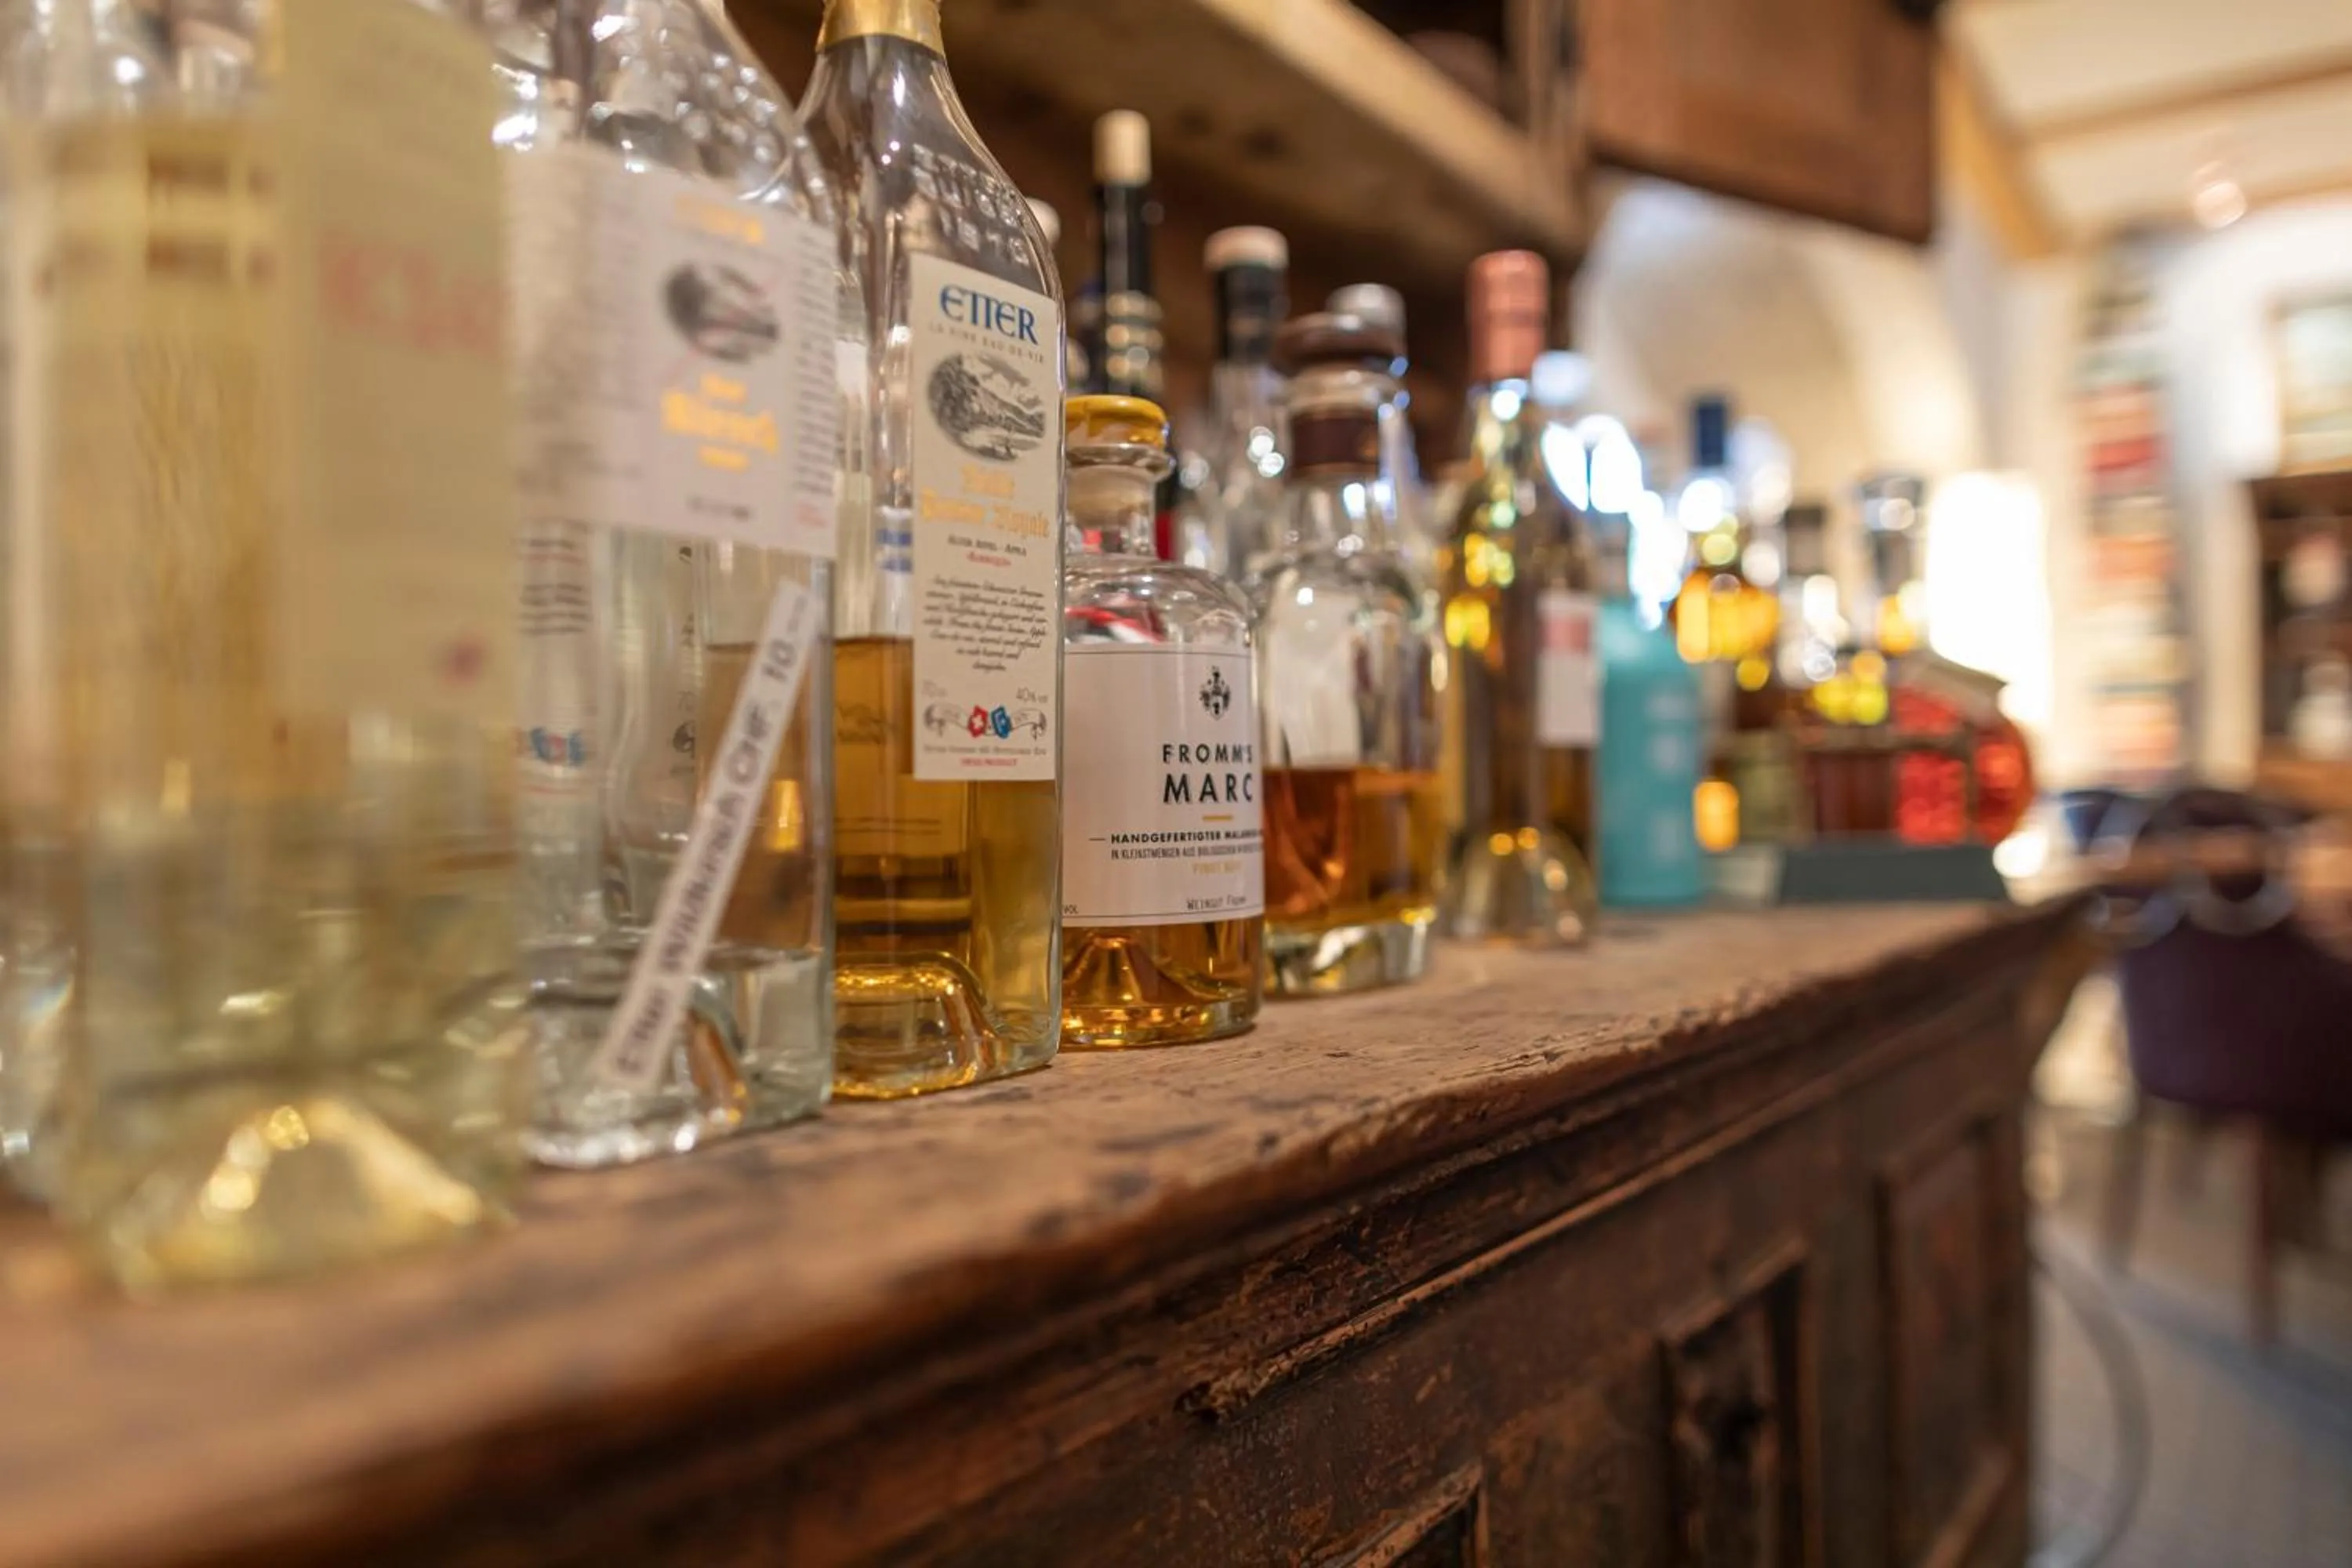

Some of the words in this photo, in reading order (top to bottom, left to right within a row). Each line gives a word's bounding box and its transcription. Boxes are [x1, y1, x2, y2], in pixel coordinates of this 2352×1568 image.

[939, 283, 1039, 346] ETTER
[1163, 772, 1253, 804] MARC
[1111, 831, 1221, 844] HANDGEFERTIGTER
